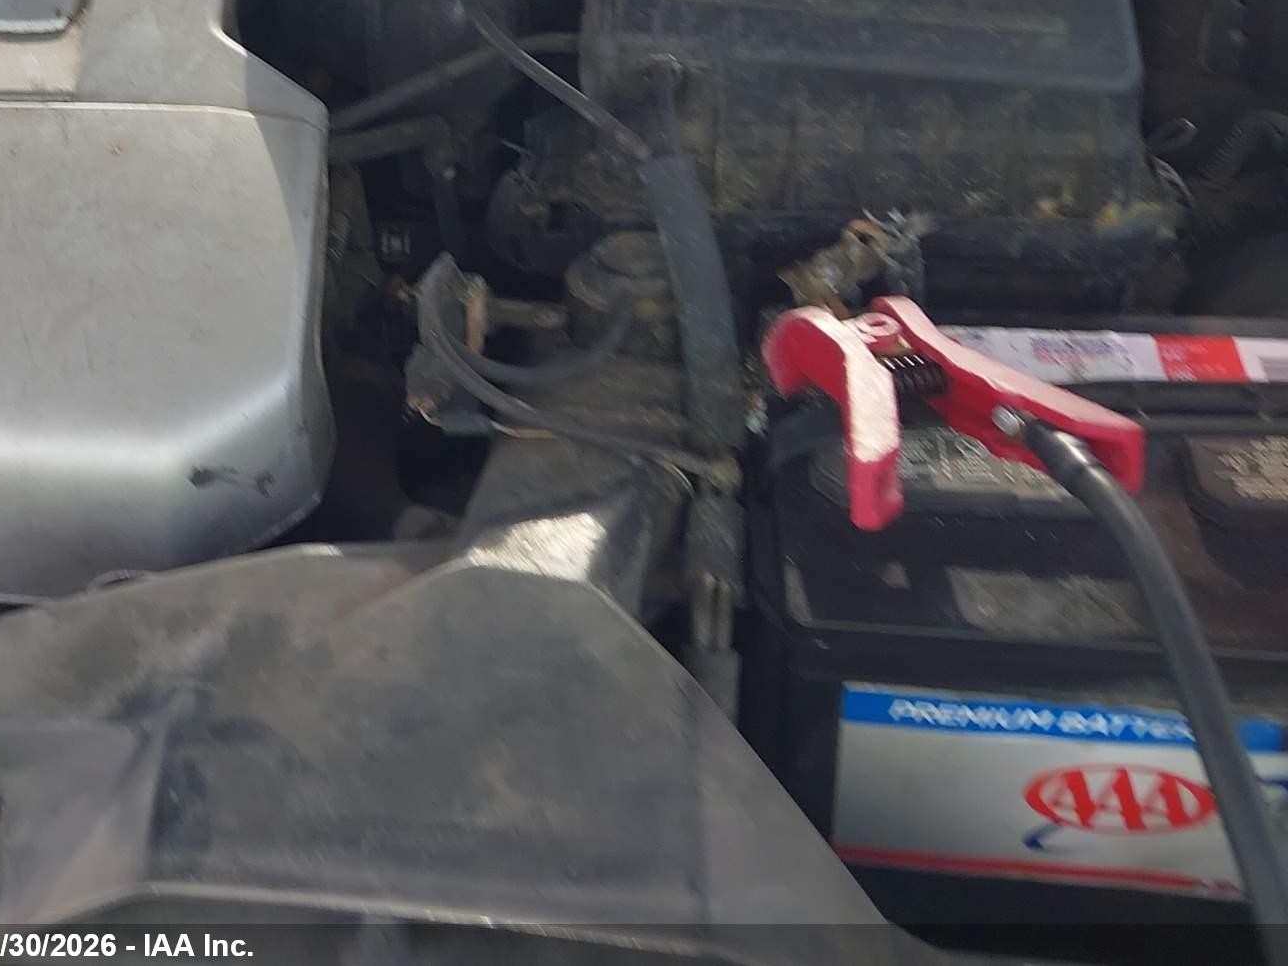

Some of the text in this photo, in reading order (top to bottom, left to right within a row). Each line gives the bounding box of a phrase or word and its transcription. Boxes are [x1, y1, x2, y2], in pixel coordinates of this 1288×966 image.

[888, 697, 1197, 741] PREMIUM BATTER
[1037, 766, 1203, 832] AAA
